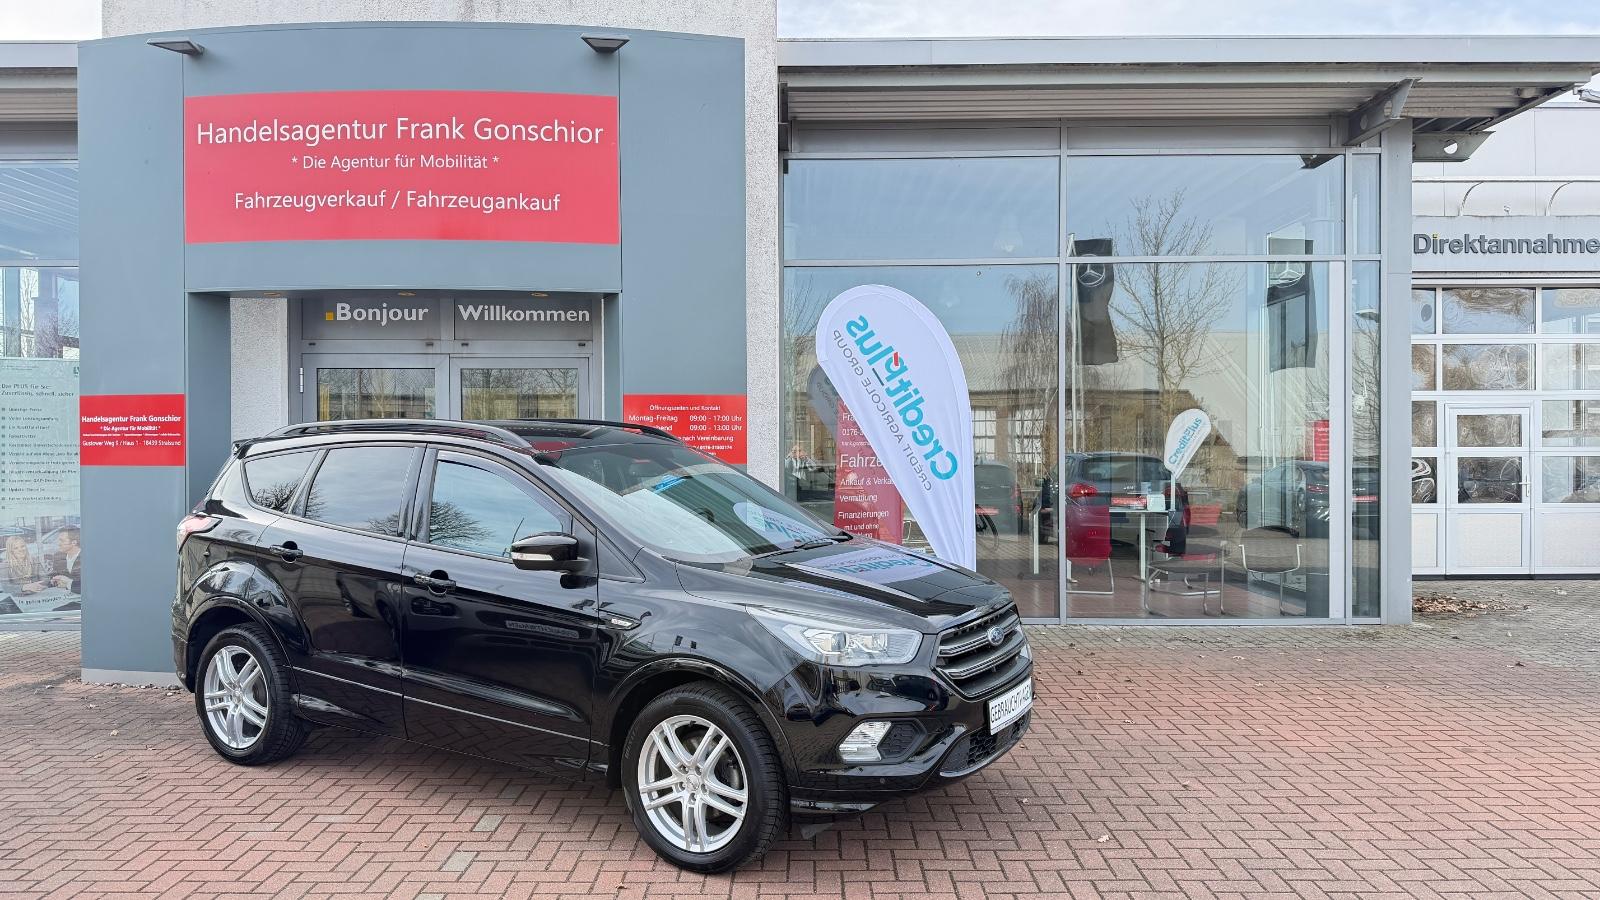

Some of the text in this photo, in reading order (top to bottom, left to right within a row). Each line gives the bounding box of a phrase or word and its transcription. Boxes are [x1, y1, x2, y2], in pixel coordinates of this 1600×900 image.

[197, 116, 604, 147] Handelsagentur Frank Gonschior
[303, 155, 326, 169] Die
[330, 154, 389, 172] Agentur
[395, 153, 414, 168] für
[420, 153, 488, 169] Mobilität
[234, 189, 561, 214] Fahrzeugverkauf / Fahrzeugankauf
[1413, 233, 1600, 254] Direktannahme
[336, 303, 429, 326] Bonjour
[458, 304, 590, 322] Willkommen
[81, 415, 128, 424] Handelsagentur
[148, 414, 181, 422] Gonschior
[696, 434, 734, 442] Vereinbarung
[1168, 417, 1202, 465] CreditPlus
[840, 476, 894, 486] Ankauf & Verka
[839, 494, 878, 503] Vermittlung
[838, 510, 889, 519] Finanzierungen
